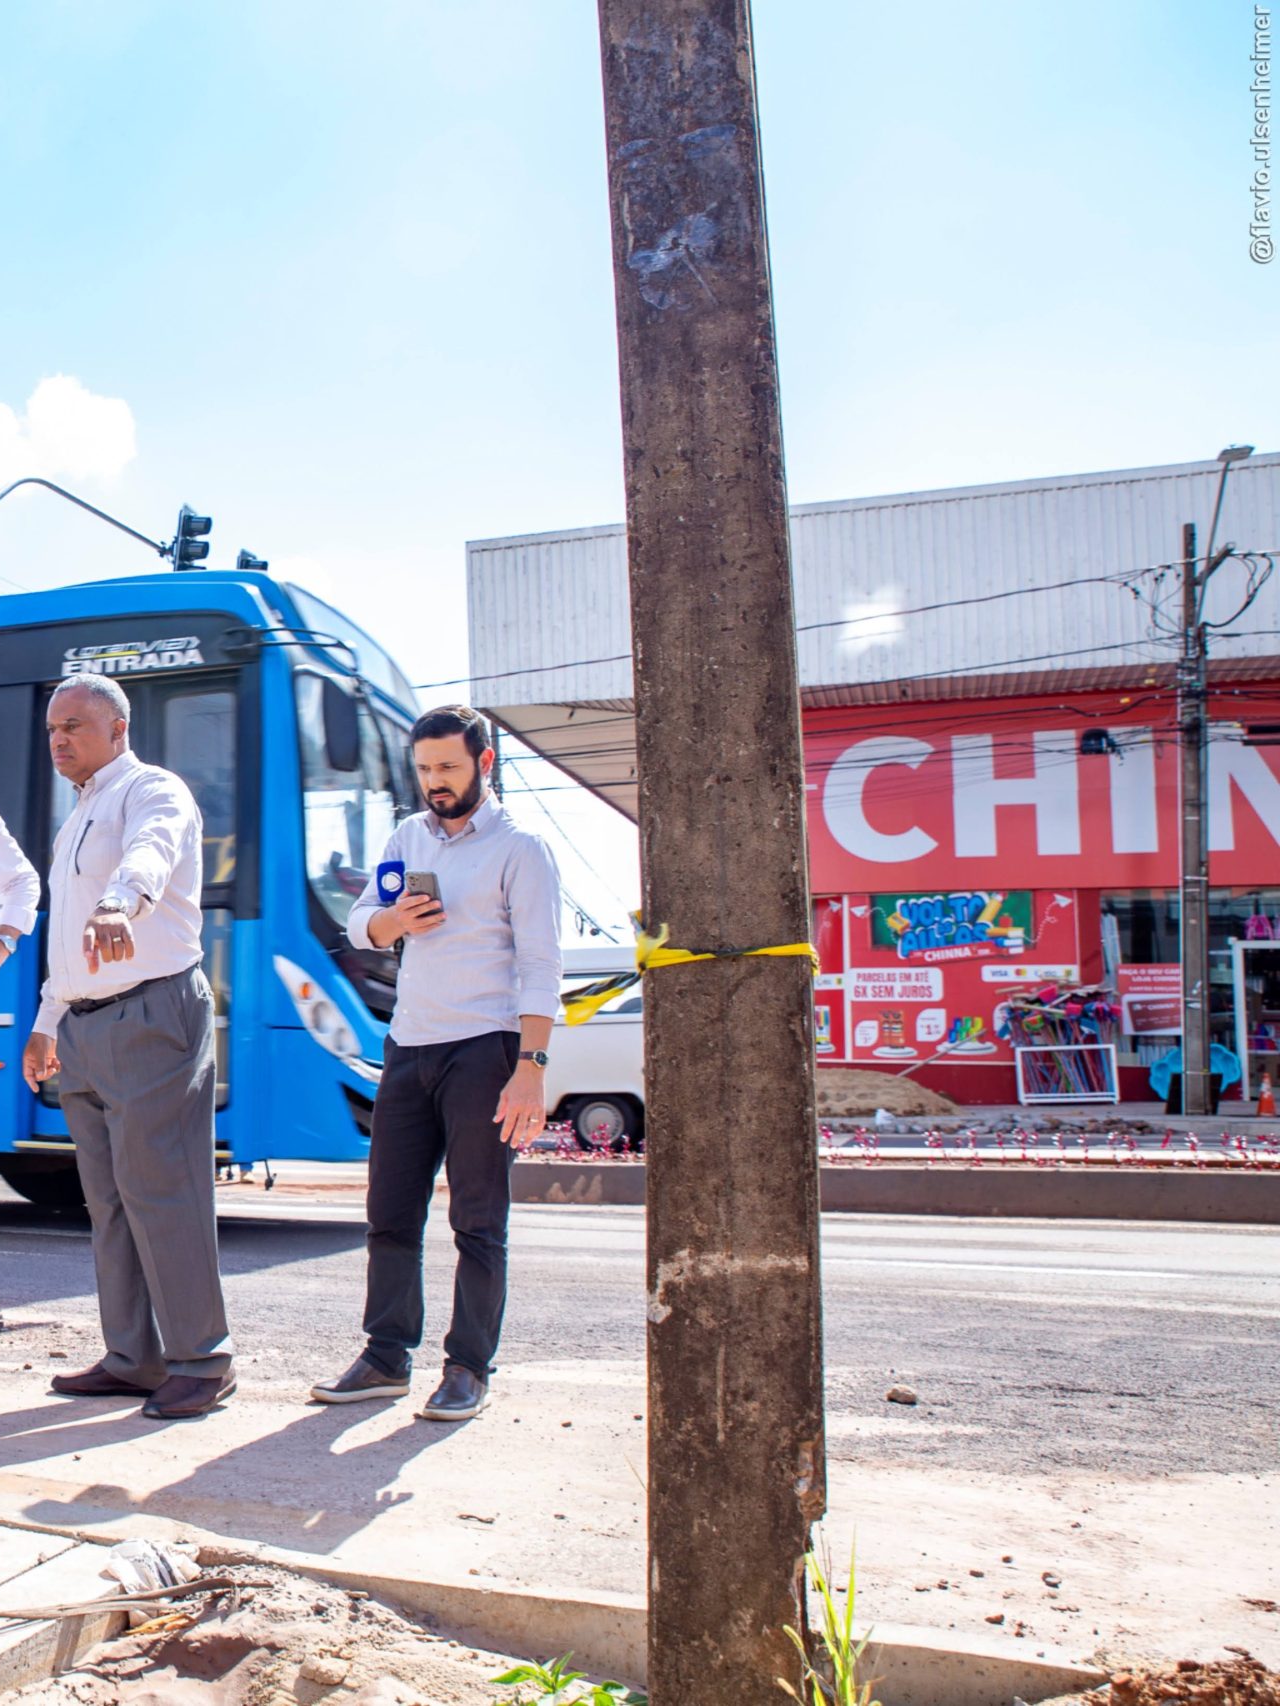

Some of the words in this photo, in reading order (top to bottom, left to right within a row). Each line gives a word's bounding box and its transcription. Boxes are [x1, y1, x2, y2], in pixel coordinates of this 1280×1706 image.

[61, 649, 205, 677] ENTRADA
[856, 972, 898, 983] PARCELAS
[899, 972, 912, 983] EM
[915, 970, 929, 983] ATÉ
[854, 985, 868, 998] 6X
[871, 985, 894, 998] SEM
[898, 985, 933, 998] JUROS
